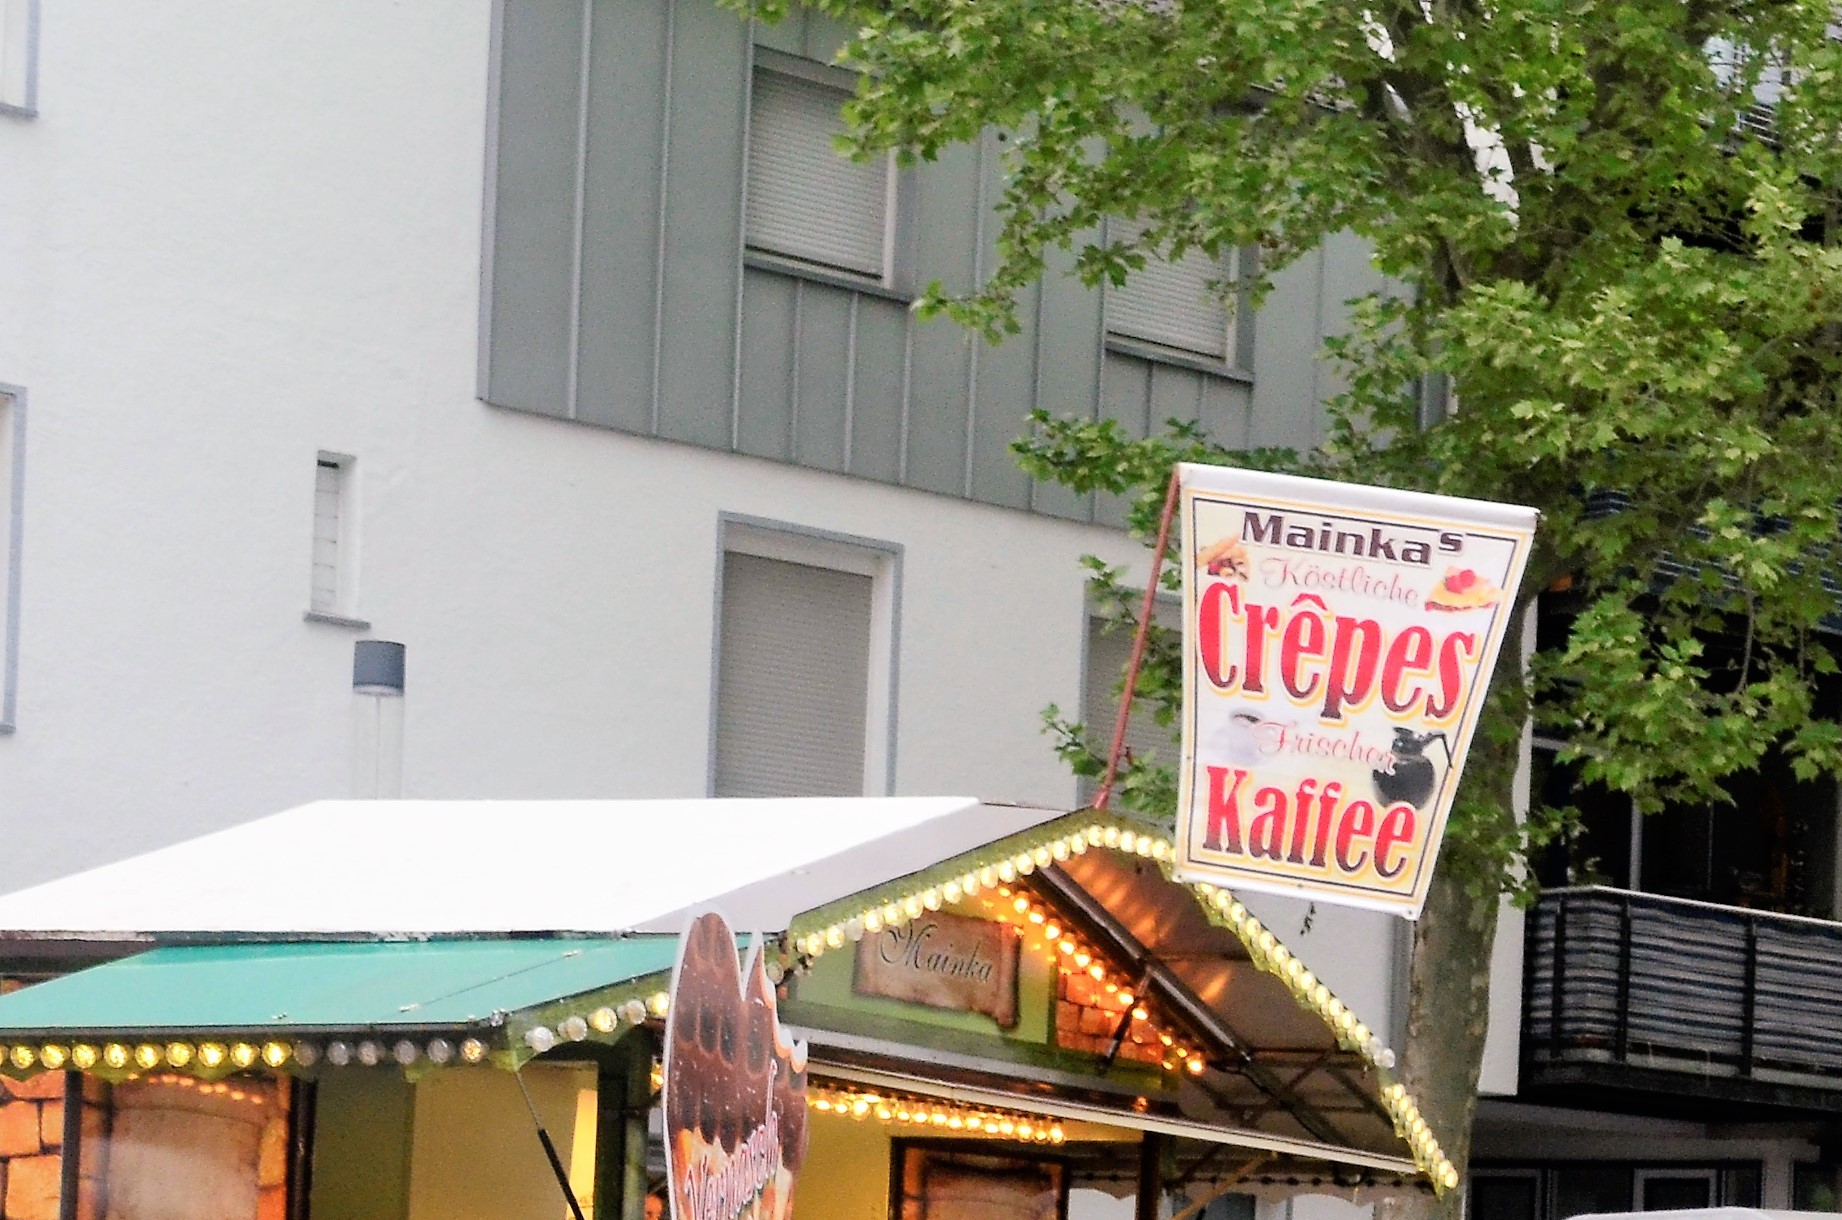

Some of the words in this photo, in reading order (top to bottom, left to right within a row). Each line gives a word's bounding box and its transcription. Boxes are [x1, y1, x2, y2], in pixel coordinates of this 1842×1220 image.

[1259, 557, 1419, 608] Köstliche
[1200, 582, 1476, 720] Crêpes
[1252, 721, 1397, 776] Frischer
[1202, 765, 1417, 878] Kaffee
[880, 918, 993, 983] Mainka
